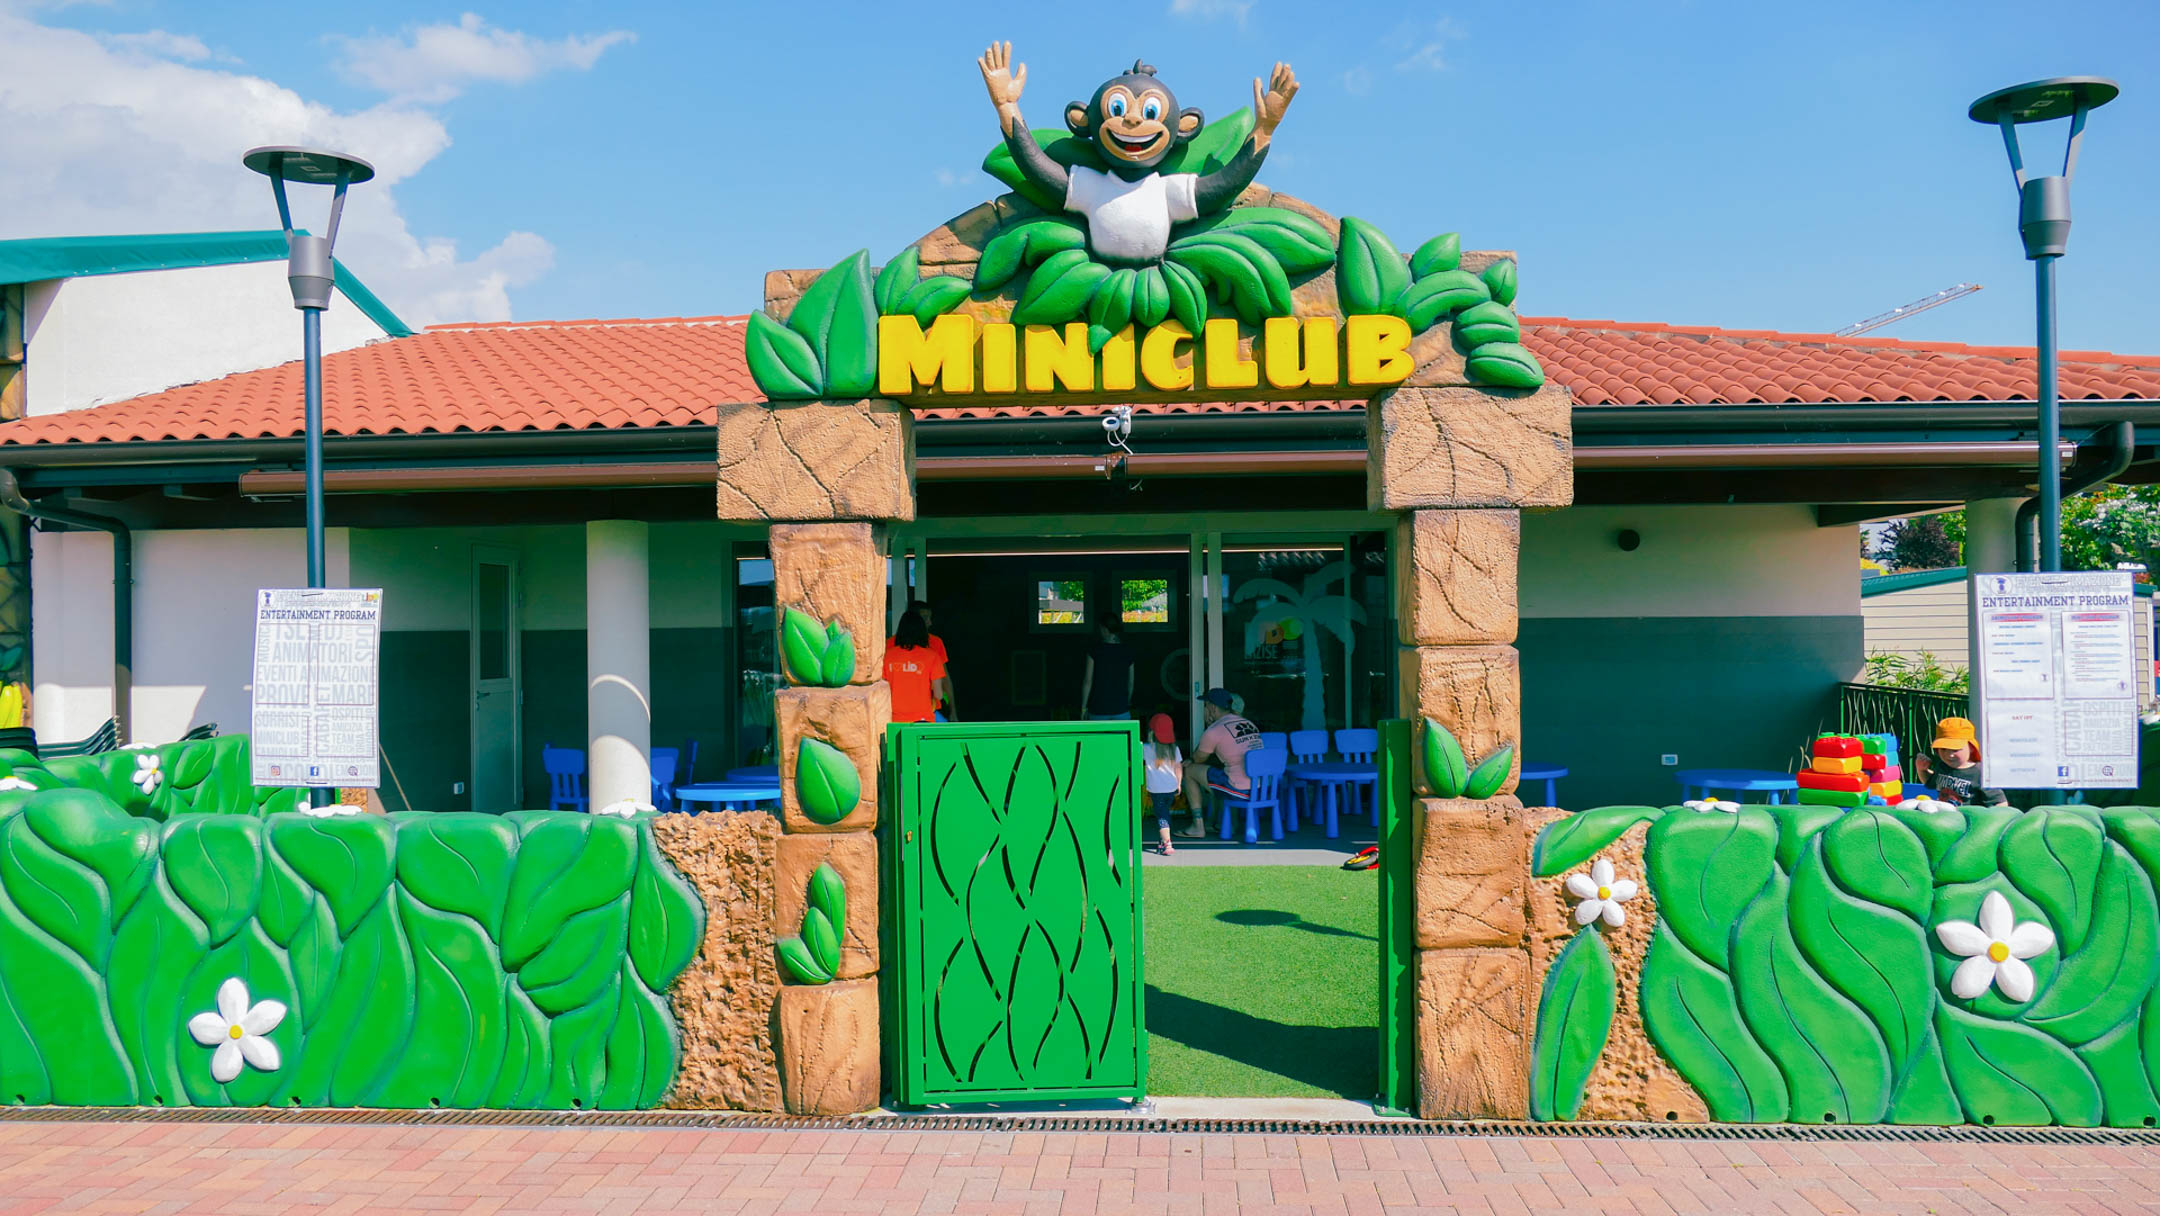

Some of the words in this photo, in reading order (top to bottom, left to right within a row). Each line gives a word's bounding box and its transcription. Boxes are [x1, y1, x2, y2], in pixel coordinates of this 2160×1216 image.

[878, 314, 1416, 394] MINICLUB
[1982, 595, 2076, 608] ENTERTAINMENT
[2079, 595, 2129, 606] PROGRAM
[260, 610, 331, 620] ENTERTAINMENT
[334, 610, 376, 620] PROGRAM
[272, 642, 353, 663] ANIMATORI
[257, 665, 297, 682] EVENTI
